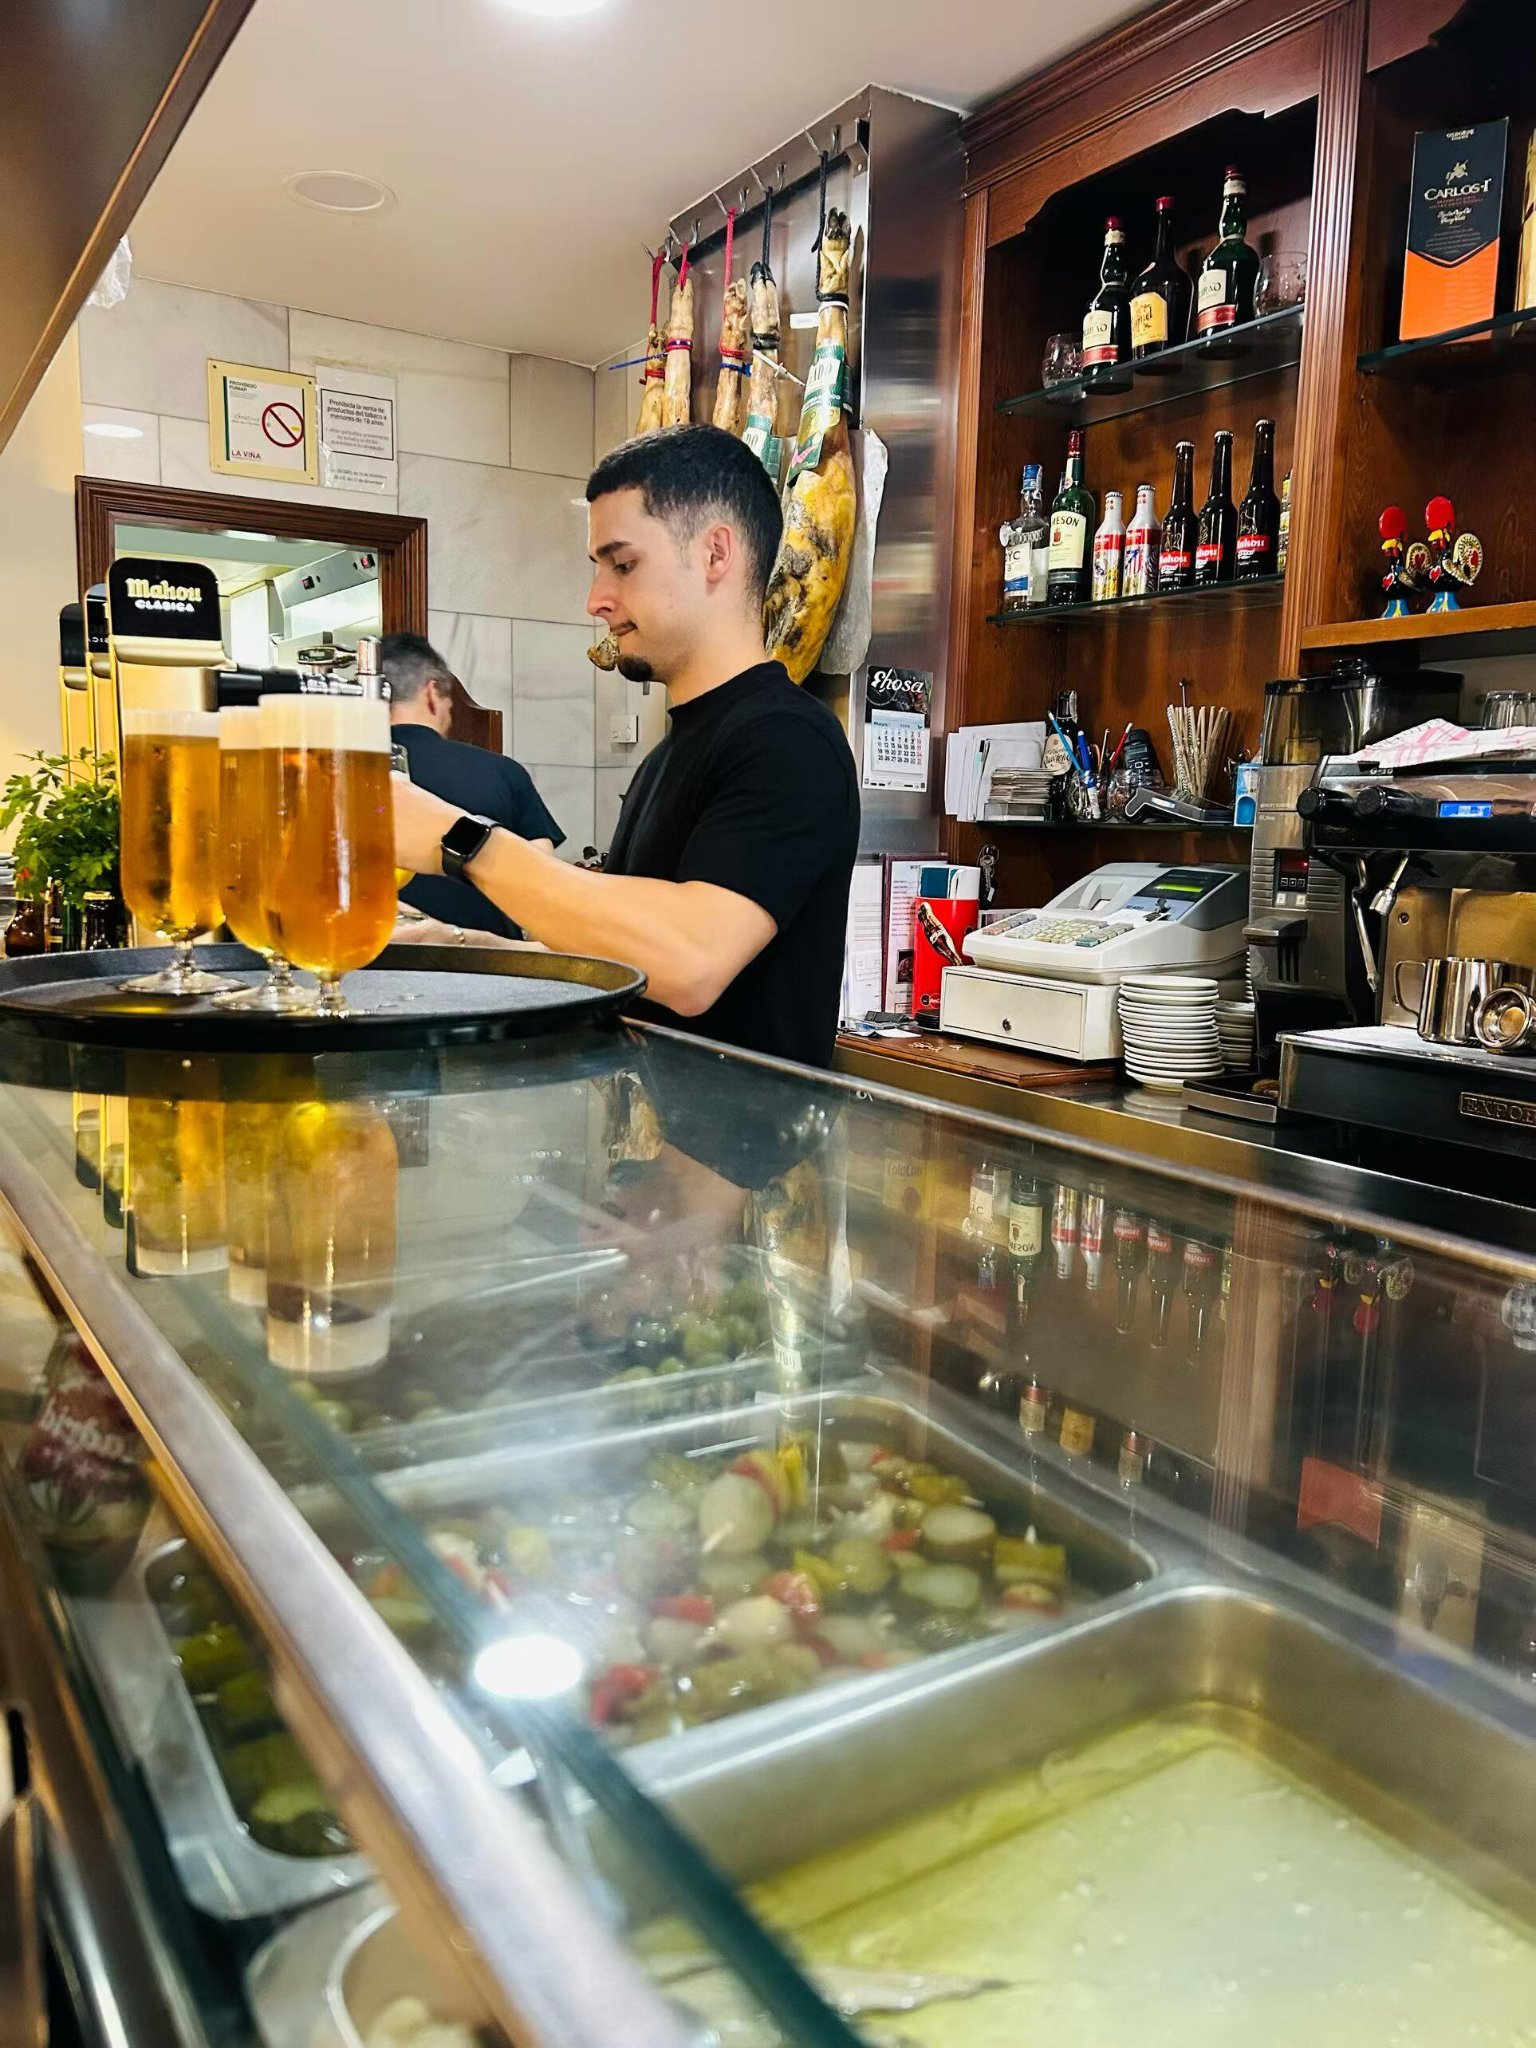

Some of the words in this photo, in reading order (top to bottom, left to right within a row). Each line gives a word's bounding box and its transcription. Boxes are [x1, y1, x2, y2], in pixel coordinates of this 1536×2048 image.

[328, 398, 356, 409] Prohibida
[327, 406, 354, 416] productos
[365, 411, 382, 420] tabaco
[330, 414, 354, 422] menores
[126, 578, 202, 602] Mahou
